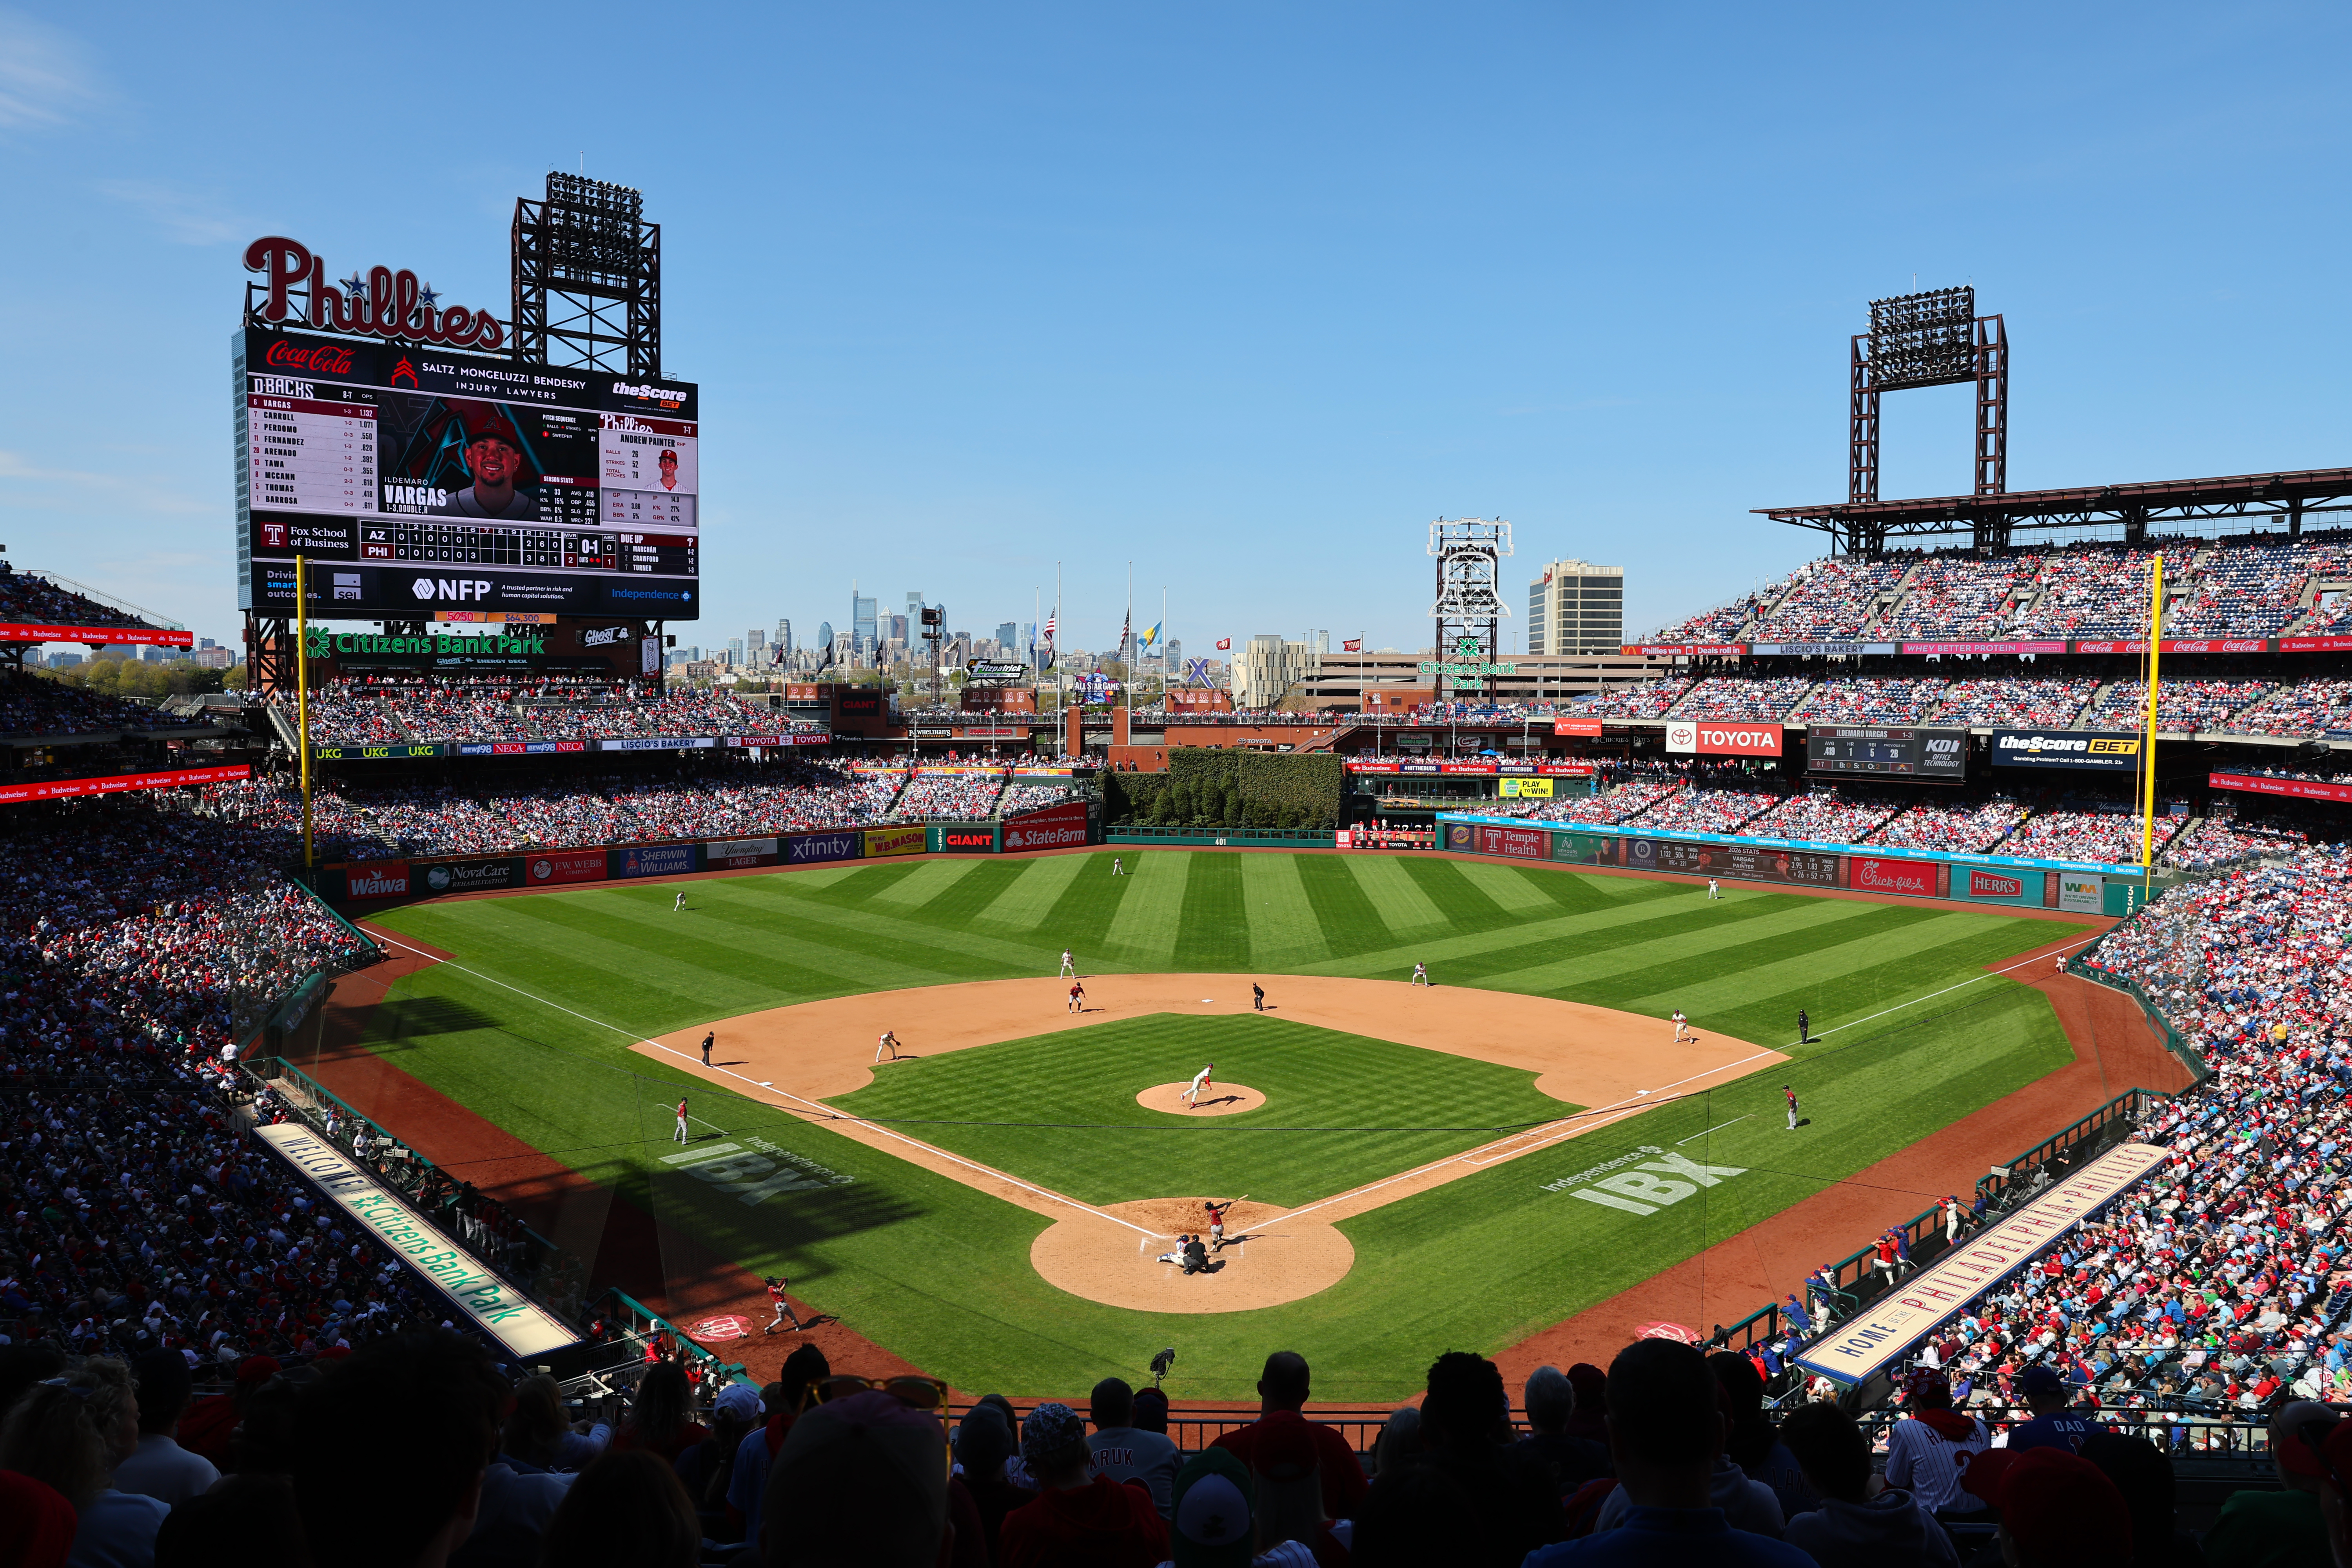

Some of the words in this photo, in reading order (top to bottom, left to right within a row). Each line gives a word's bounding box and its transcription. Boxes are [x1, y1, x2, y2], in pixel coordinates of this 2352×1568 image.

[243, 236, 505, 350] Phillies
[266, 340, 356, 374] Coca-Cola
[423, 363, 454, 374] SALTZ
[461, 368, 528, 383] MONGELUZZI
[534, 377, 586, 390] BENDESKY
[456, 381, 497, 393] INJURY
[507, 388, 556, 399] LAWYERS
[613, 383, 686, 401] theScore
[263, 400, 291, 409] VARGAS
[264, 412, 294, 421] CARROLL
[264, 424, 297, 433] PERDOMO
[264, 436, 304, 446] FERNANDEZ
[621, 434, 647, 445] ANDREW
[649, 436, 675, 447] PAINTER
[265, 448, 297, 457] ARENADO
[265, 460, 284, 468] TAWA
[265, 472, 295, 481] MCCANN
[385, 477, 428, 486] ILDEMARO
[266, 484, 294, 492] THOMAS
[266, 495, 298, 505] BARROSA
[384, 485, 446, 506] VARGAS
[290, 527, 309, 535] Fox
[313, 528, 347, 538] School
[369, 531, 385, 540] AZ
[290, 538, 301, 546] of
[305, 538, 349, 548] Business
[621, 534, 633, 543] DUE
[635, 535, 643, 544] UP
[368, 547, 387, 556] PHI
[439, 579, 491, 601] NFP
[612, 589, 679, 599] Independence
[585, 626, 620, 647] GHOST
[336, 633, 431, 653] Citizens
[437, 633, 494, 653] Bank
[497, 633, 545, 654] Park
[1780, 644, 1822, 654] LISCIO'S
[1824, 644, 1865, 654] BAKERY
[2081, 642, 2115, 652] Coca-Cola
[1642, 647, 1666, 655] Phillies
[1421, 661, 1477, 674] Citizens
[1480, 661, 1516, 674] Bank
[1452, 676, 1483, 690] Park
[1700, 730, 1775, 748] TOYOTA
[1837, 729, 1864, 738] ILDEMARO
[1999, 736, 2087, 751] theScore
[2093, 741, 2134, 751] BET
[408, 746, 433, 756] UKG
[51, 785, 80, 794] Budweiser
[947, 835, 993, 845] GIANT
[1504, 831, 1539, 843] Temple
[721, 843, 765, 857] Yuengling
[793, 837, 850, 859] xfinity
[1504, 844, 1537, 855] Health
[641, 849, 687, 861] SHERWIN
[555, 862, 571, 870] F.W.
[574, 859, 602, 868] WEBB
[641, 861, 687, 873] WILLIAMS
[729, 857, 757, 866] LAGER
[451, 865, 509, 879] NovaCare
[1860, 866, 1924, 890] Chick-fil-A
[351, 878, 406, 896] Wawa
[452, 878, 508, 887] REHABILITATION
[1975, 877, 2016, 893] HERR'S
[2065, 882, 2097, 894] WM
[744, 1136, 835, 1176] Independence
[279, 1137, 364, 1189] WELCOME
[658, 1142, 828, 1207] IBX
[1539, 1151, 1644, 1192] Independence
[2062, 1148, 2156, 1201] PHILLIES
[1569, 1152, 1748, 1216] IBX
[1898, 1200, 2081, 1314] PHILADELPHIA
[364, 1206, 437, 1265] Citizens
[417, 1251, 480, 1290] Bank
[459, 1285, 529, 1325] Park
[1895, 1310, 1911, 1319] THE
[1835, 1323, 1897, 1358] HOME
[2053, 1420, 2085, 1432] DAD
[1089, 1447, 1134, 1472] KRUK
